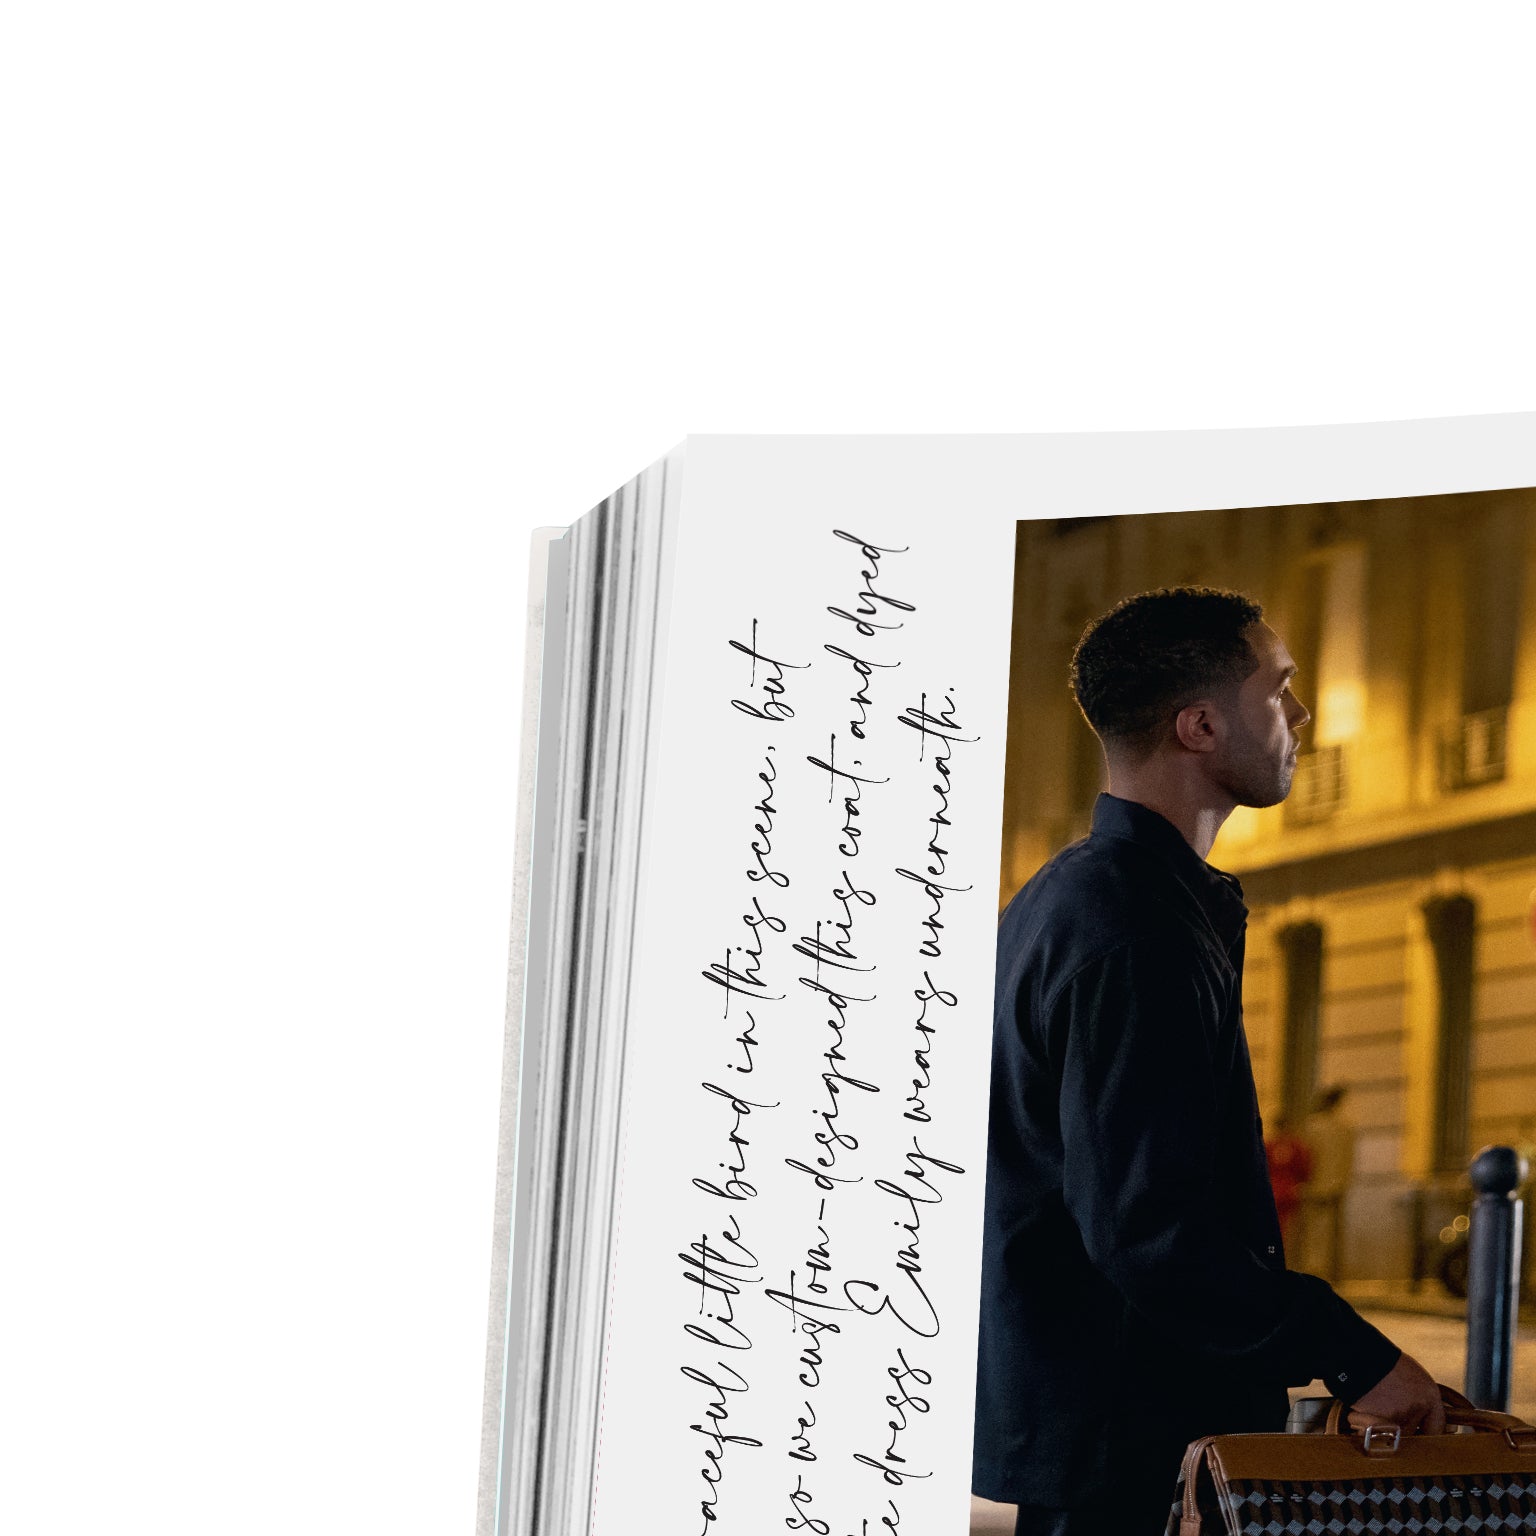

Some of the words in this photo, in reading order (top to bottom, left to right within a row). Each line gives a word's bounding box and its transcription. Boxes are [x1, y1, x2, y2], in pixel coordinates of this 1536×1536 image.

[827, 530, 916, 636] dyed
[728, 618, 811, 721] but
[824, 644, 901, 739] and
[746, 746, 789, 887] scene,
[896, 686, 981, 957] underneath.
[702, 897, 786, 1019] this
[793, 871, 876, 991] this
[727, 1011, 758, 1073] in
[903, 971, 958, 1122] wears
[692, 1082, 780, 1200] bird
[764, 978, 879, 1387] custom-designed
[678, 1215, 763, 1350] little
[844, 1137, 964, 1337] Emily
[788, 1401, 817, 1461] we
[853, 1348, 933, 1485] dress
[785, 1475, 830, 1535] so
